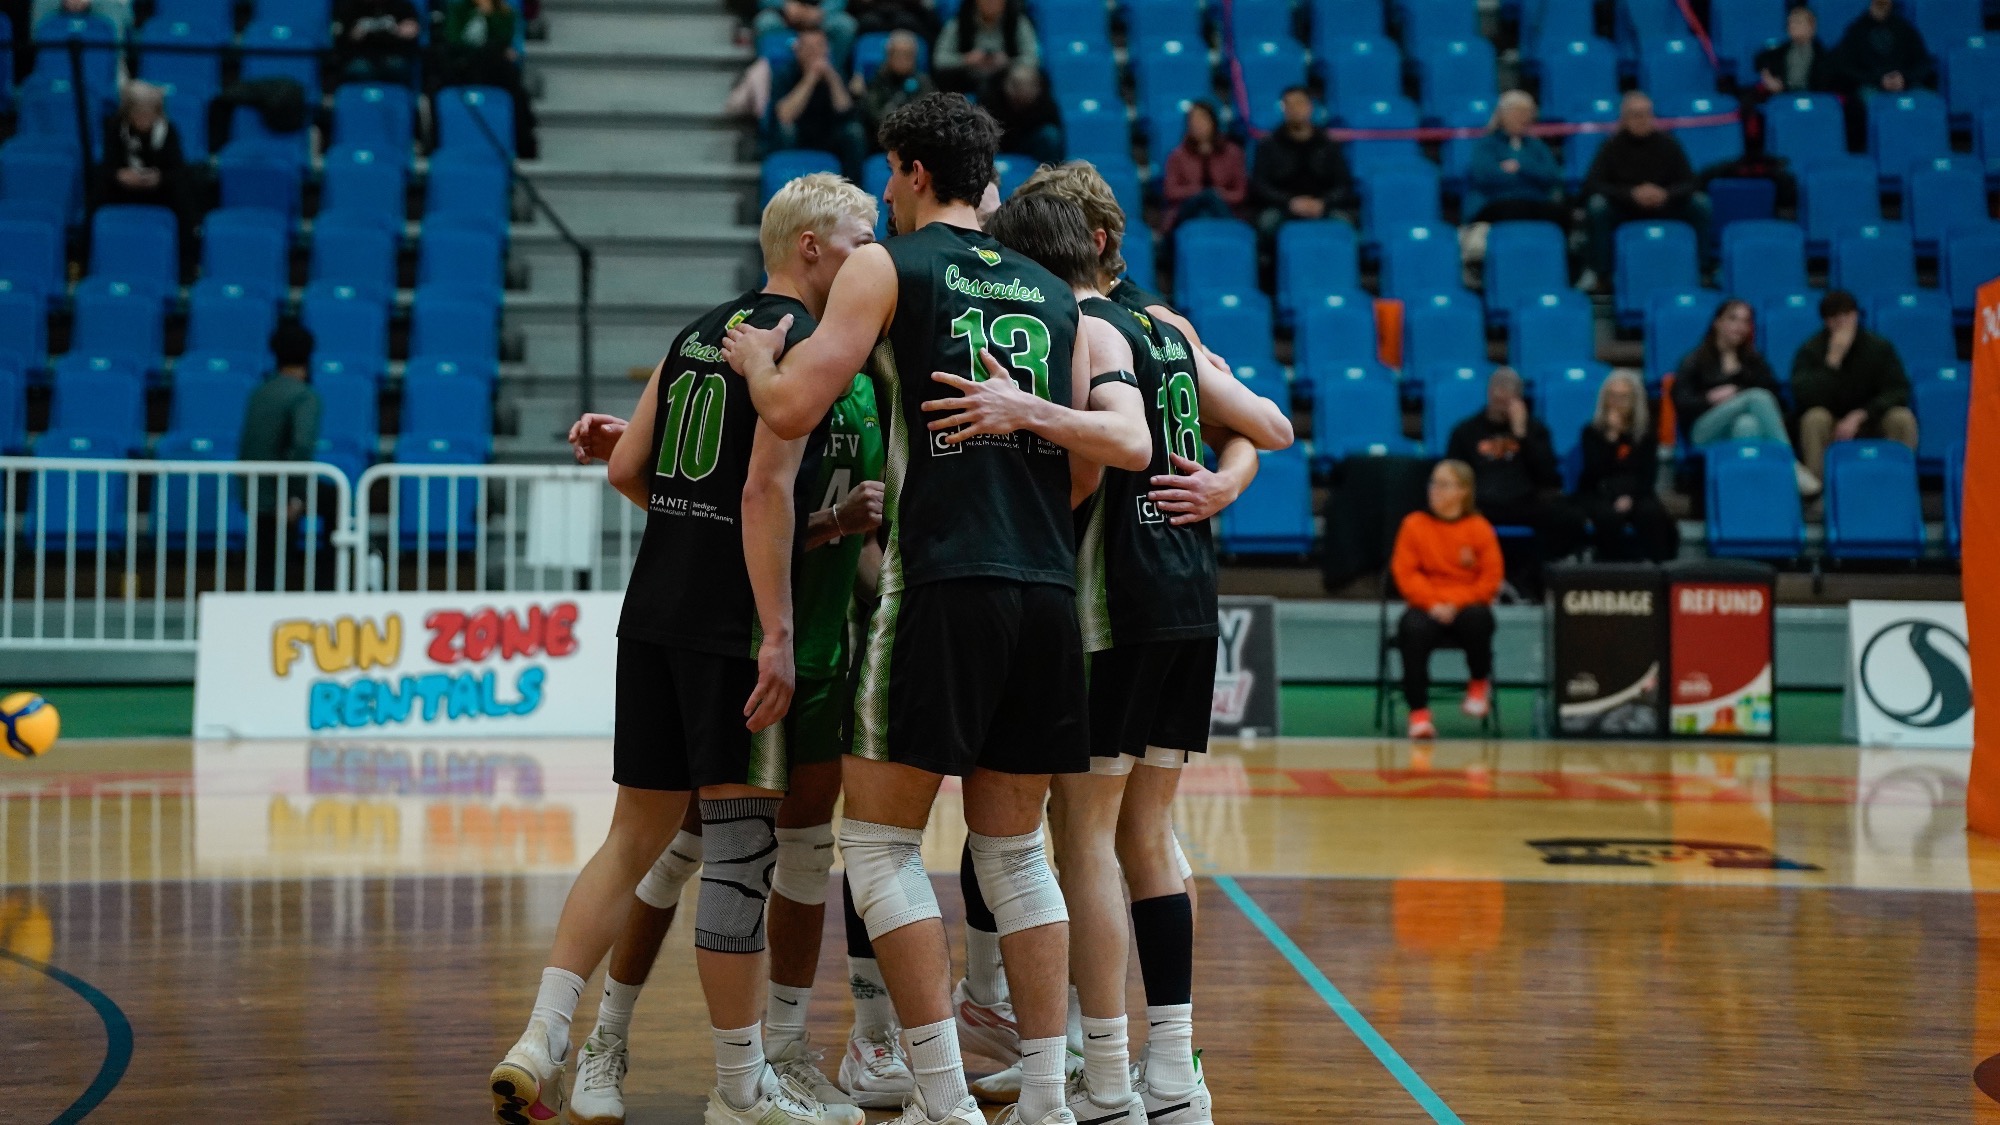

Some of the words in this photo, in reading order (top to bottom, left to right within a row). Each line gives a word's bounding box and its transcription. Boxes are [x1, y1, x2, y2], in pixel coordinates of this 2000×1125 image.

[945, 264, 1045, 303] Cascades
[951, 307, 1051, 401] 13
[656, 370, 727, 482] 10
[1157, 372, 1204, 475] 18
[1563, 589, 1653, 616] GARBAGE
[1679, 588, 1764, 614] REFUND
[273, 613, 404, 677] FUN
[425, 600, 580, 664] ZONE
[308, 665, 547, 731] RENTALS
